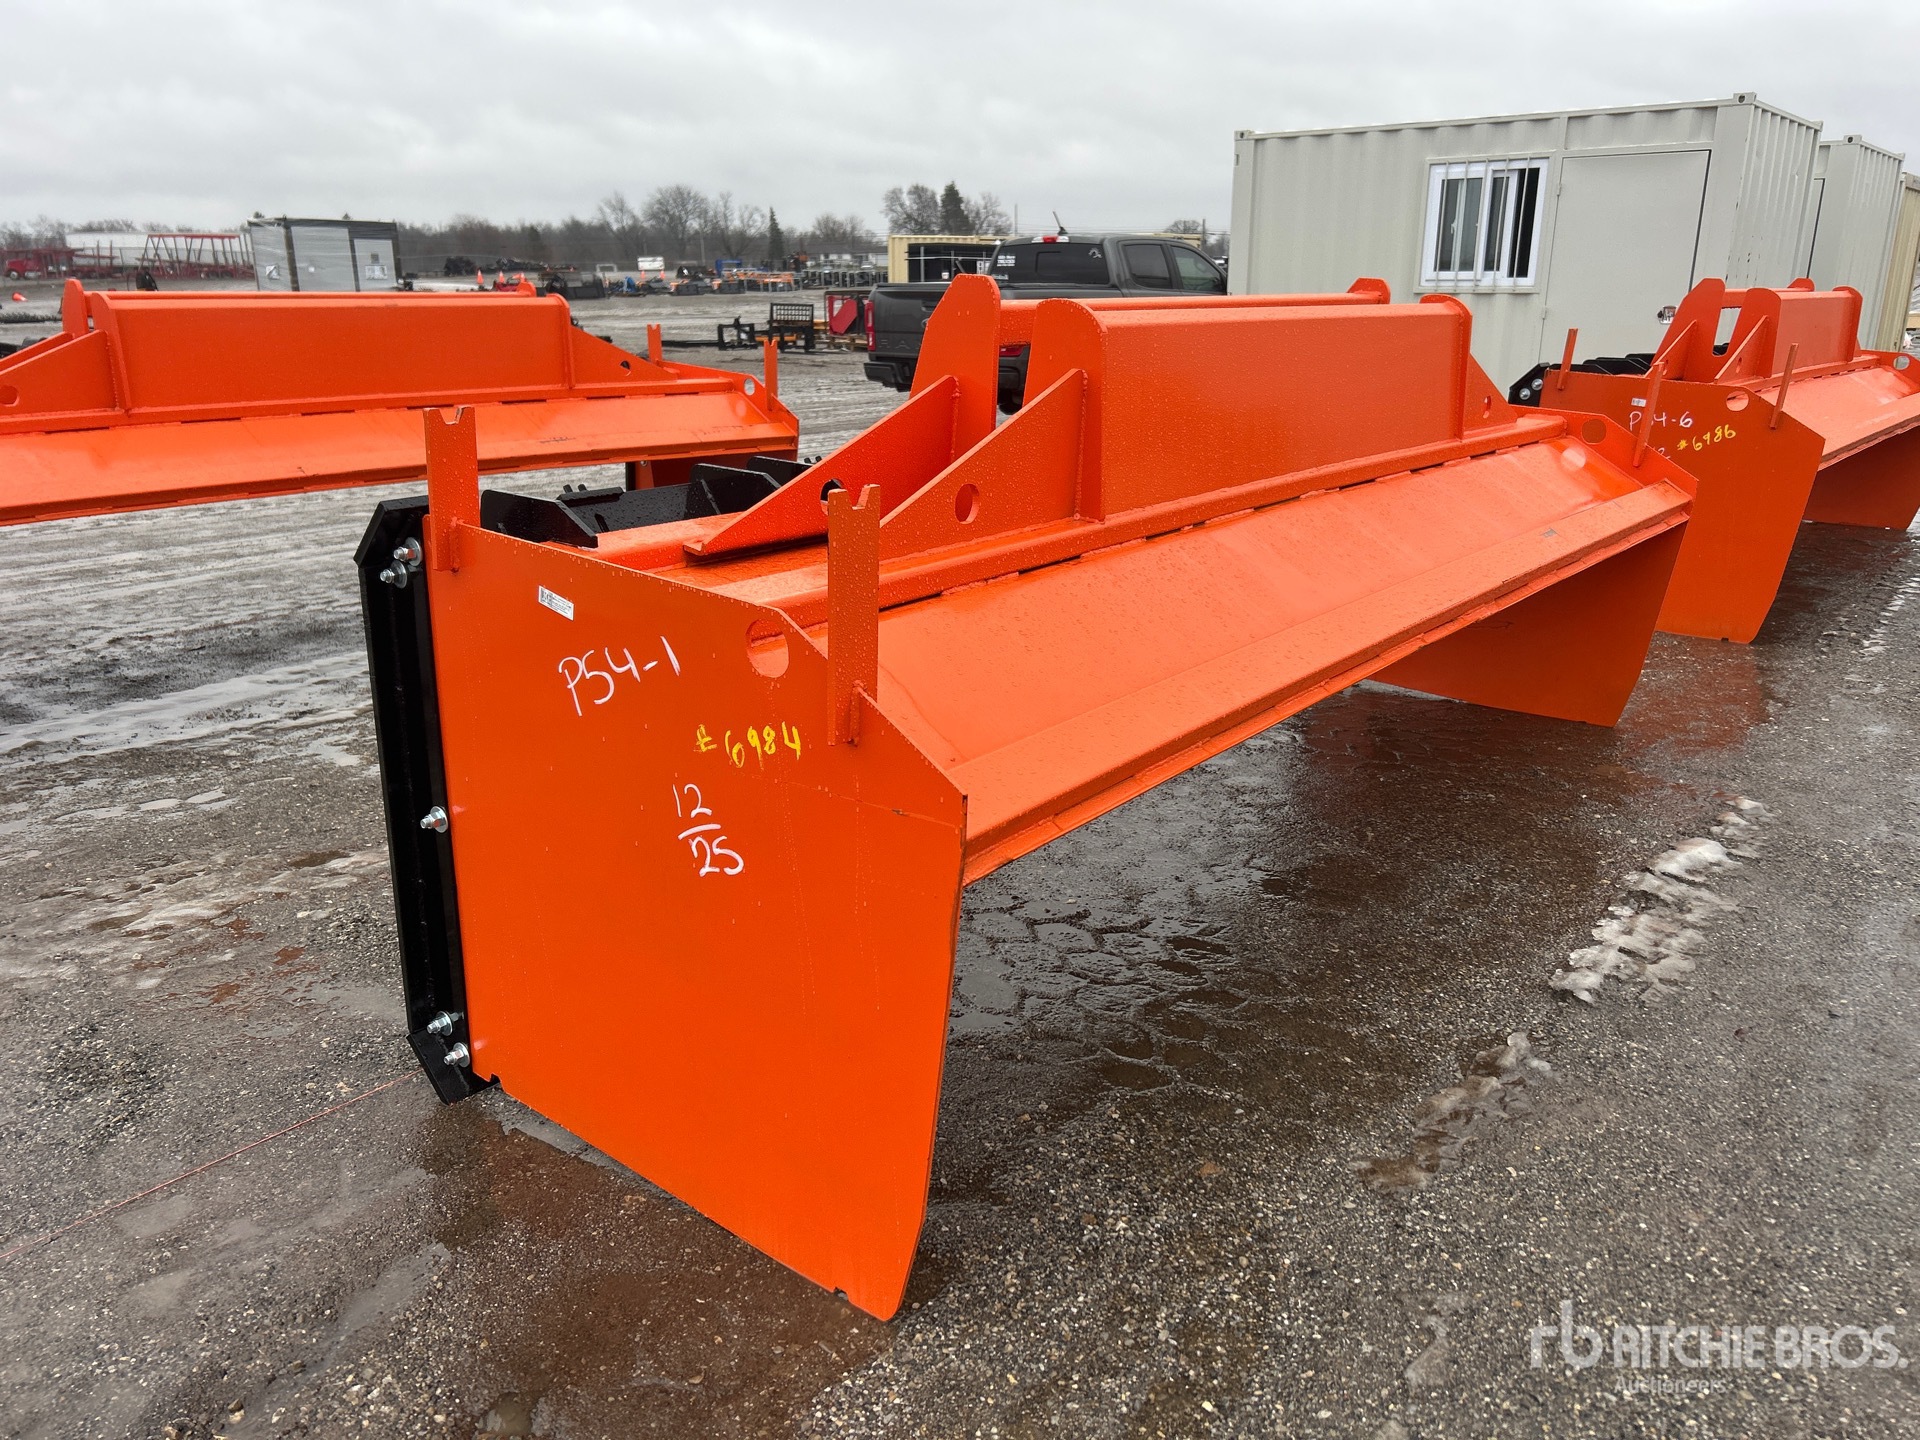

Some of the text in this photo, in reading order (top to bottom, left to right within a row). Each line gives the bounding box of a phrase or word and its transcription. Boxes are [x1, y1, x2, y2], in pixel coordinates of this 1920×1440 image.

[1629, 410, 1694, 431] P4-6
[558, 635, 681, 716] P54-1
[672, 783, 712, 818] 12
[688, 835, 744, 877] 25
